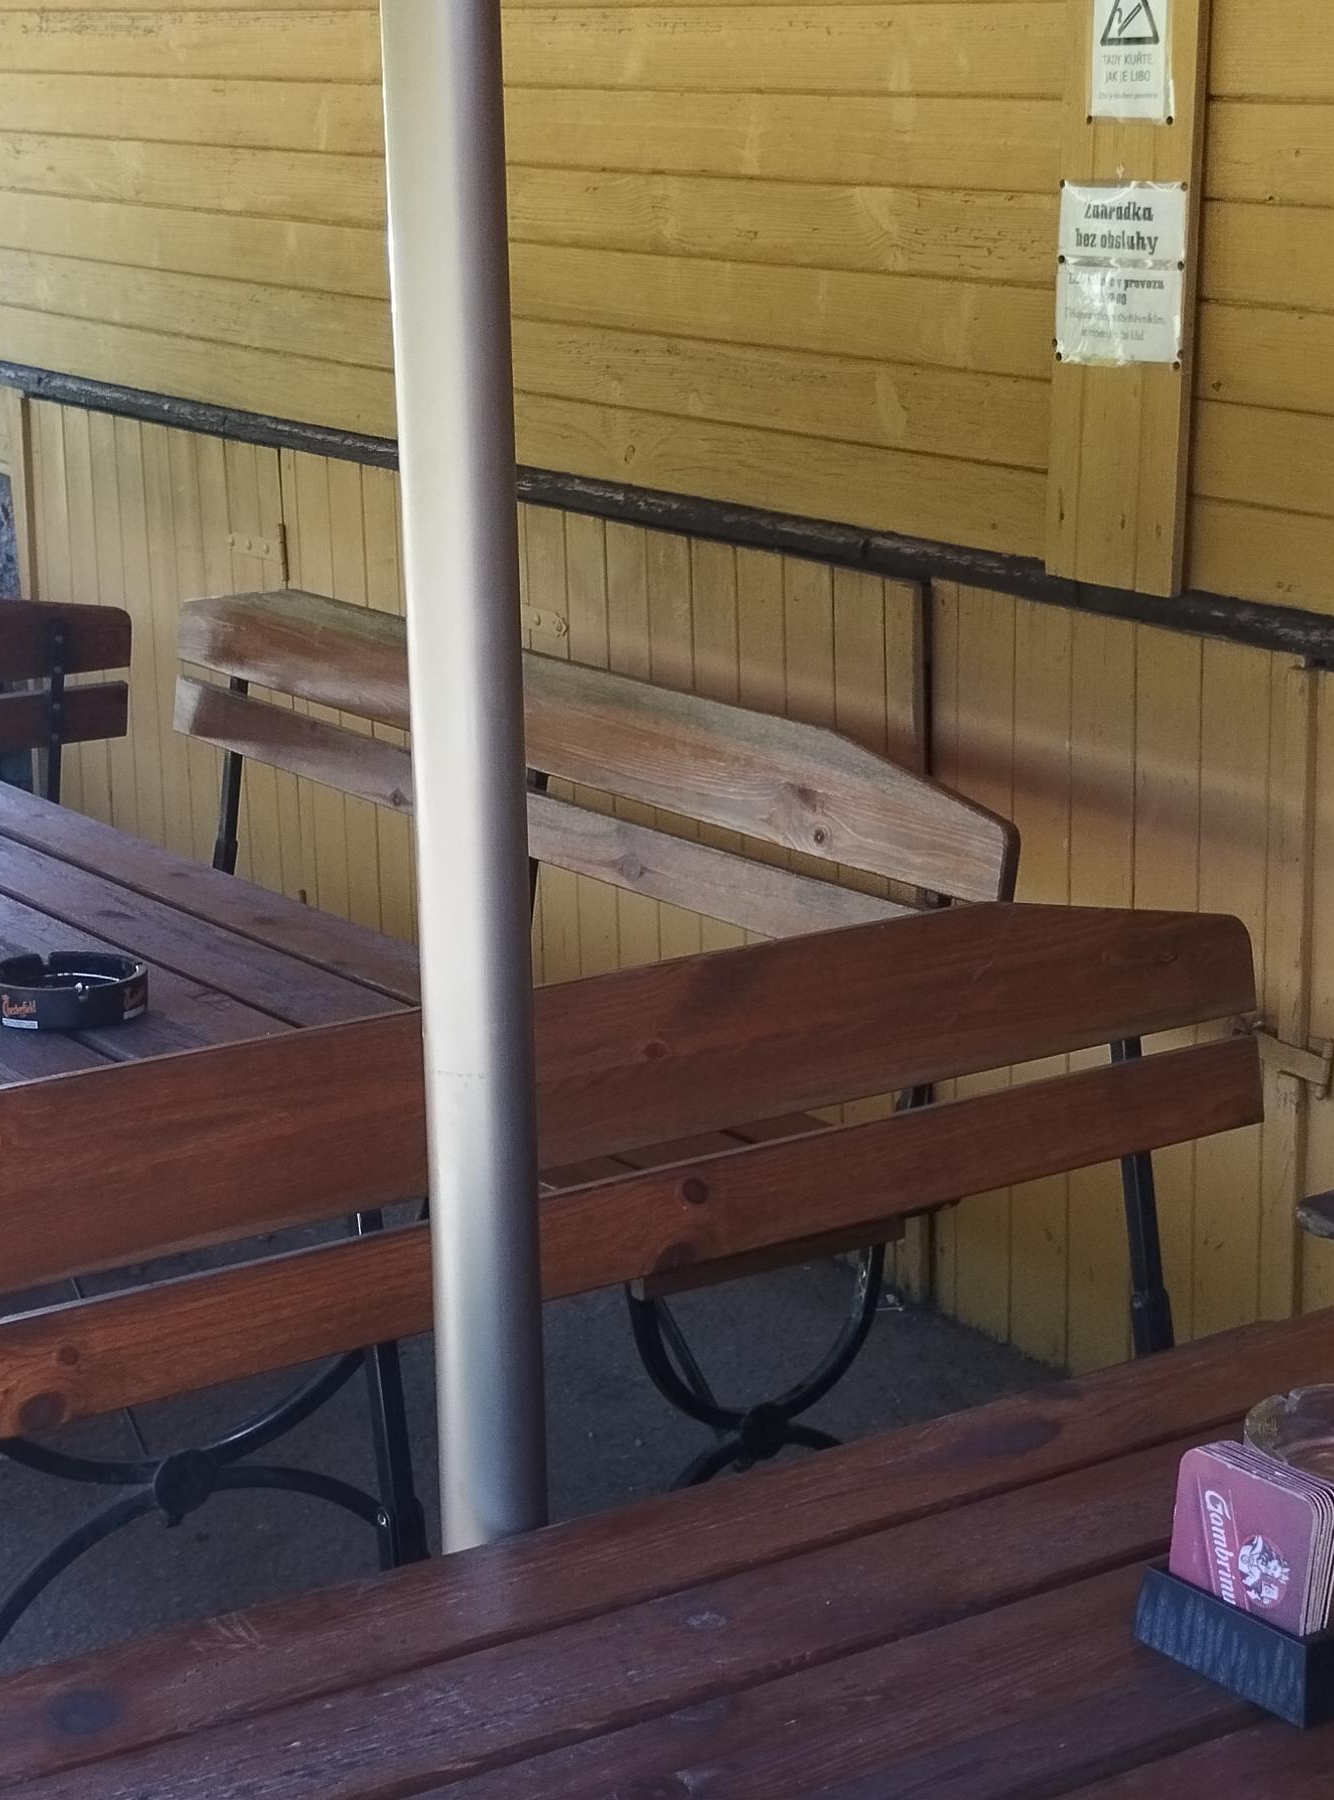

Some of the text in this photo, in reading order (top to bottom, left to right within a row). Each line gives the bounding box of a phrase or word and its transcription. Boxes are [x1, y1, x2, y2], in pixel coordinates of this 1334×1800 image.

[1130, 70, 1152, 82] LIBO
[1076, 228, 1158, 255] bez obsluhy
[1124, 279, 1164, 290] provozu
[1204, 1490, 1236, 1605] Gambrinu
